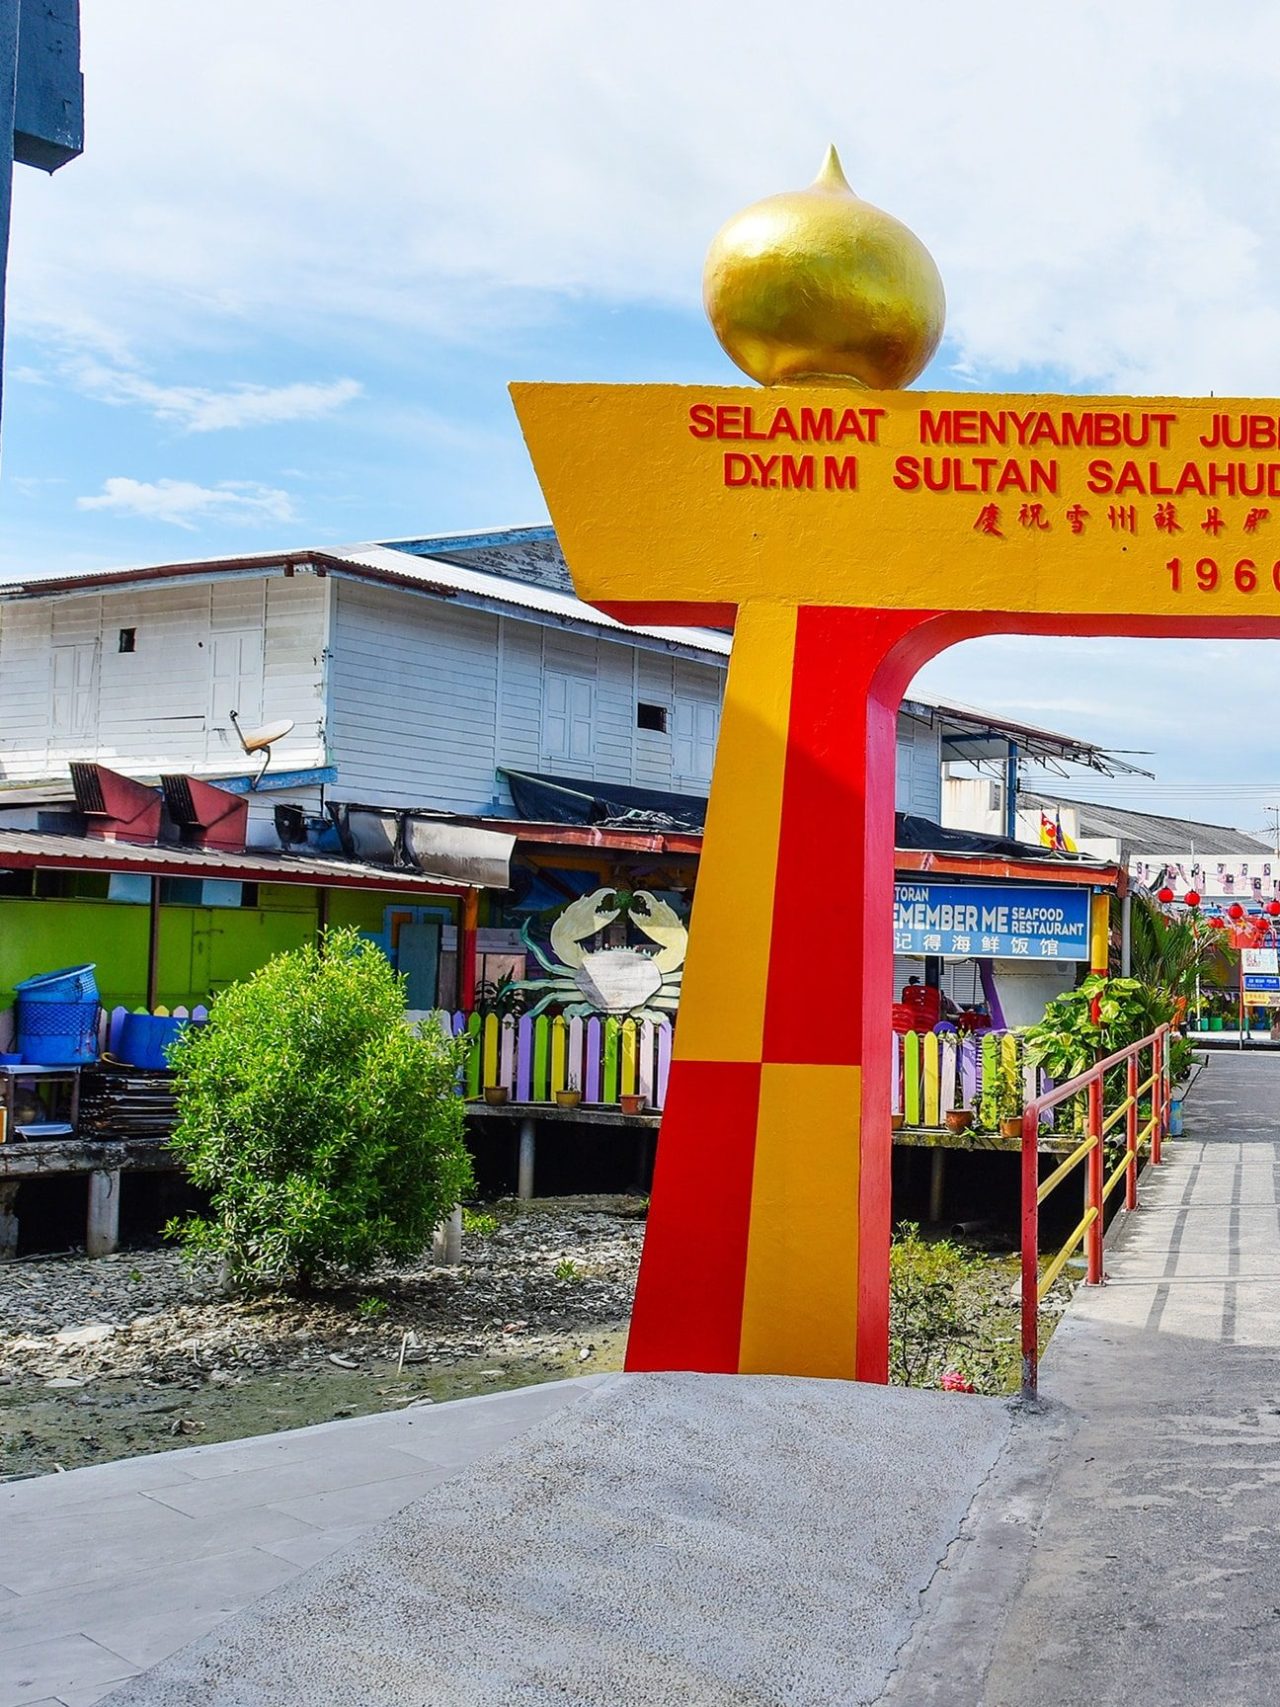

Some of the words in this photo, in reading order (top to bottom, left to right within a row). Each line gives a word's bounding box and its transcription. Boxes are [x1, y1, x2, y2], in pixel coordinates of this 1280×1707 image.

[688, 403, 886, 444] SELAMAT
[919, 409, 1177, 449] MENYAMBUT
[892, 455, 1058, 495] SULTAN
[894, 886, 929, 902] TORAN
[893, 902, 978, 932] EMEMBER
[981, 906, 1009, 933] ME
[1011, 906, 1064, 921] SEAFOOD
[1011, 920, 1084, 936] RESTAURANT
[894, 932, 1059, 956] 记得海鲜饭馆
